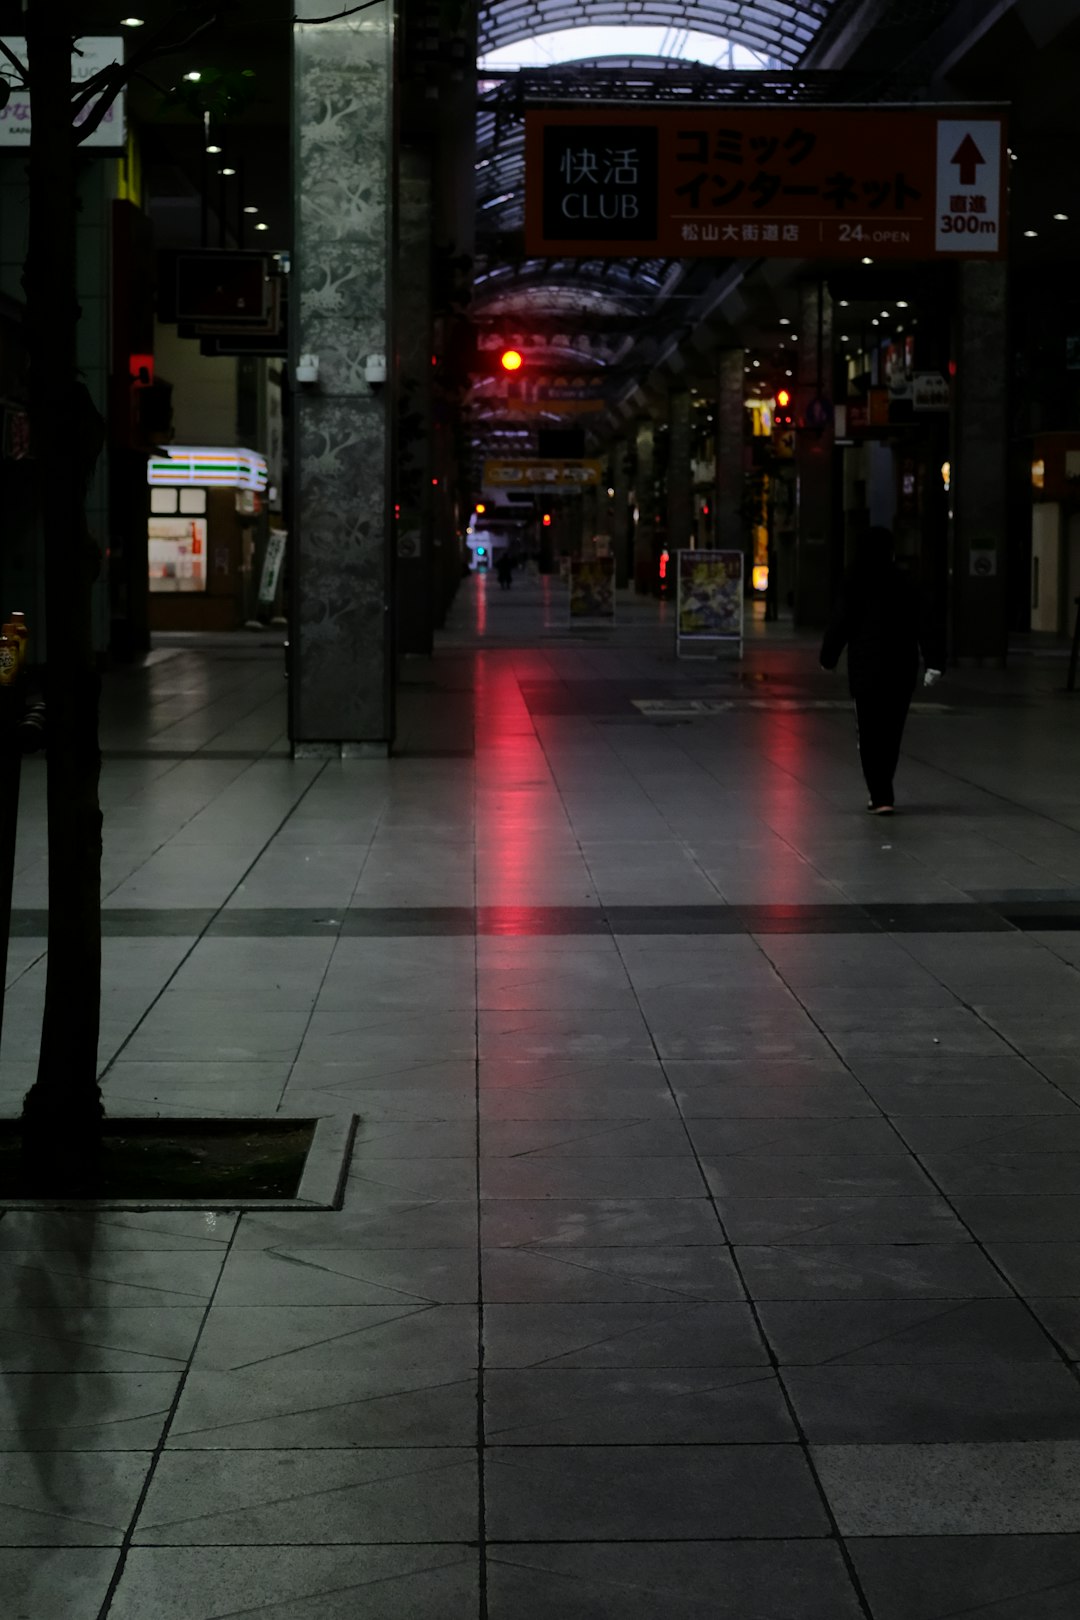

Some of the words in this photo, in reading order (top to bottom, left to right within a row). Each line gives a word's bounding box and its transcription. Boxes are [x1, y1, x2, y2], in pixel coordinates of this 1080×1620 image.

[676, 127, 816, 165] コミック
[559, 147, 640, 185] 快活
[674, 171, 922, 210] インターネット
[561, 193, 640, 219] CLUB
[950, 195, 986, 213] 直進
[680, 223, 800, 242] 松山大街道店
[941, 215, 996, 234] 300m
[872, 231, 911, 243] OPEN
